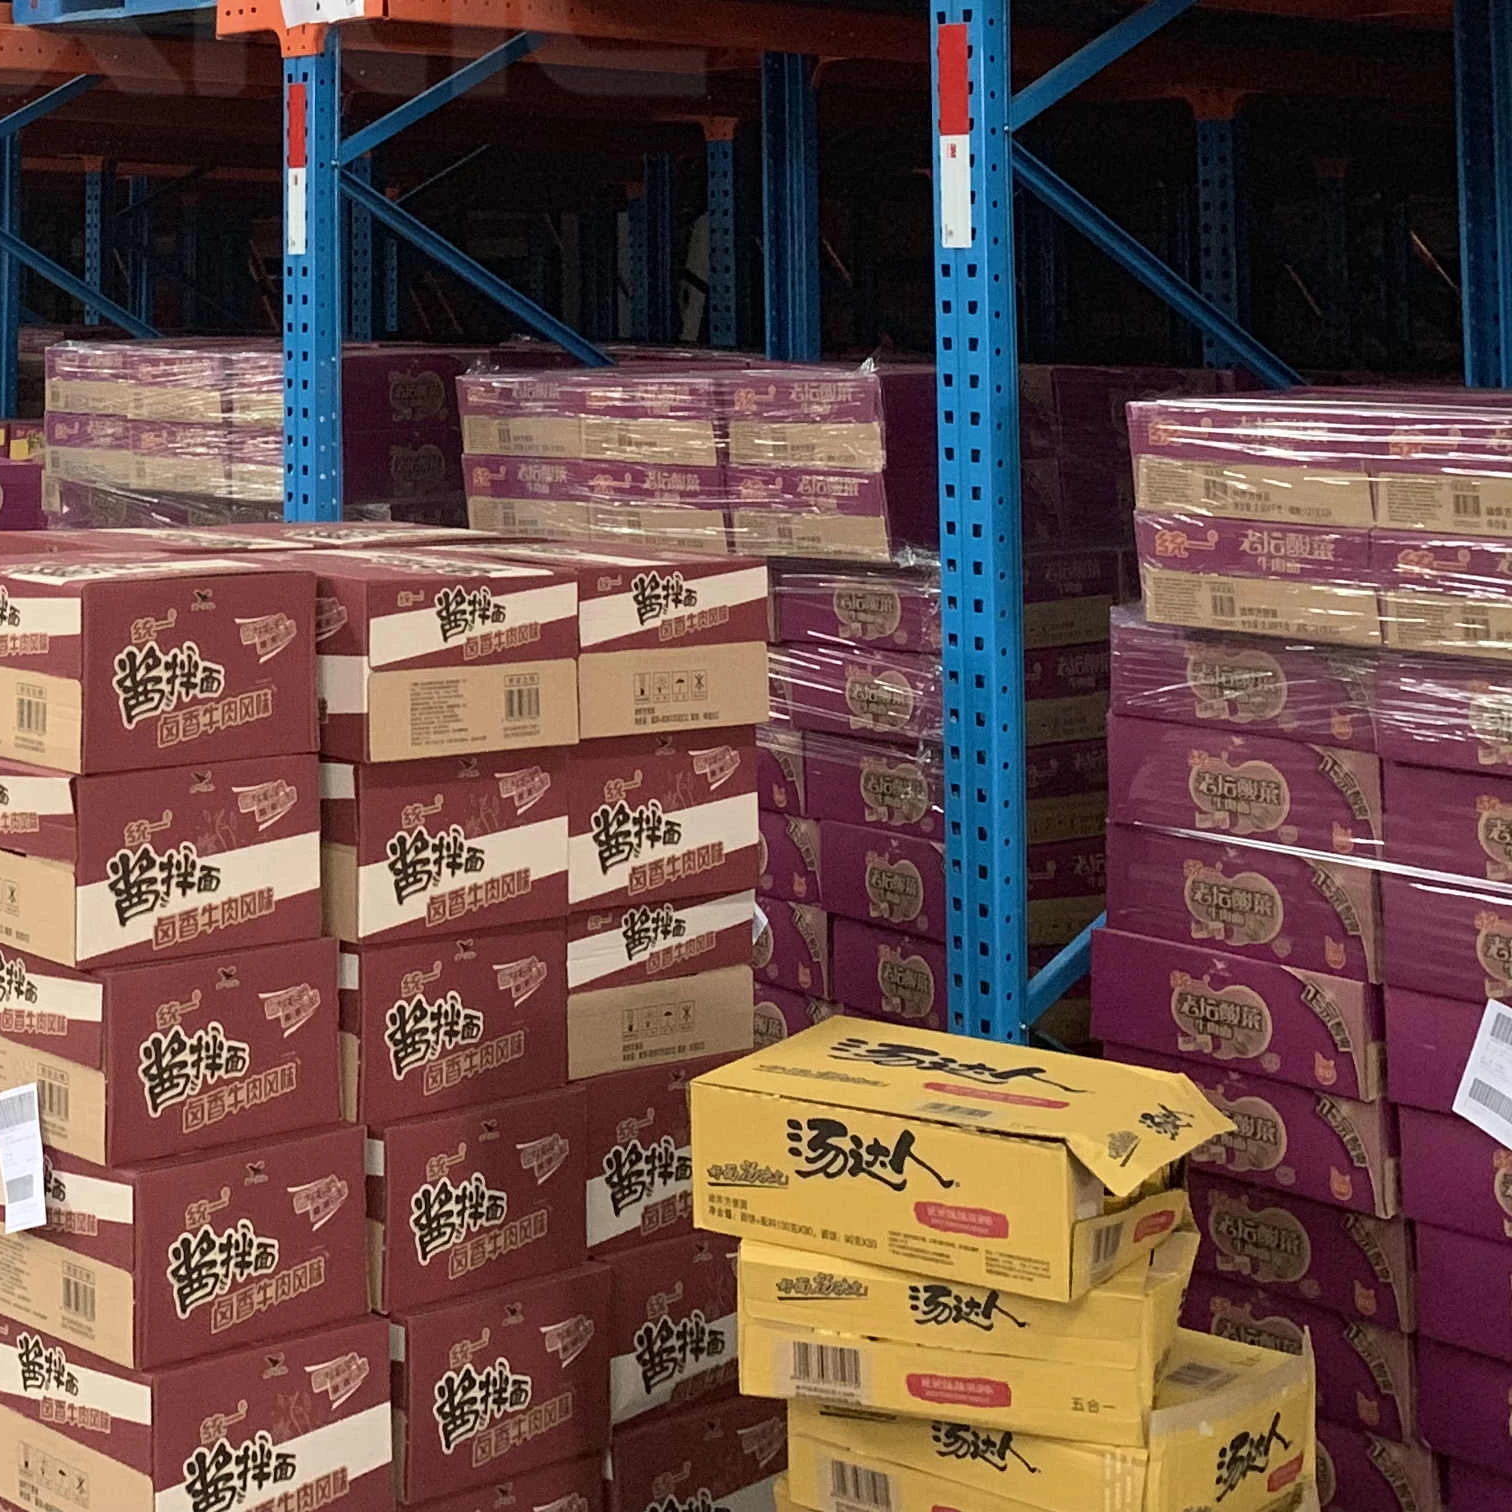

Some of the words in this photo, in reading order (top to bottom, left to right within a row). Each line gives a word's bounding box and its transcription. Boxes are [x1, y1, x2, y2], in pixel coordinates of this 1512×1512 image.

[1239, 528, 1336, 561] 老坛酸菜
[130, 609, 177, 642] 统一
[435, 586, 506, 643] 酱拌面
[632, 571, 697, 626] 酱拌面
[658, 605, 729, 641] 卤香牛肉风味
[464, 622, 541, 660] 卤香牛肉风味
[113, 641, 224, 729] 酱拌面
[158, 693, 273, 748] 卤香牛肉风味
[1198, 770, 1283, 806] 老坛酸菜
[124, 810, 172, 845] 统一
[592, 800, 681, 875] 酱拌面
[108, 843, 221, 926] 酱拌面
[386, 825, 484, 904] 酱拌面
[629, 842, 724, 895] 卤香牛肉风味
[153, 887, 275, 949] 卤香牛肉风味
[426, 868, 531, 926] 卤香牛肉风味
[622, 904, 686, 960] 酱拌面
[1, 1007, 67, 1034] 卤香牛肉风味
[156, 990, 201, 1027] 统一
[386, 991, 483, 1079] 酱拌面
[1179, 995, 1264, 1032] 老坛酸菜
[138, 1022, 248, 1115] 酱拌面
[423, 1029, 525, 1096] 卤香牛肉风味
[827, 1037, 1093, 1094] 汤达人
[183, 1064, 296, 1134] 卤香牛肉风味
[786, 1117, 955, 1191] 汤达人
[185, 1188, 230, 1228] 统一
[410, 1171, 506, 1265] 酱拌面
[167, 1219, 278, 1318] 酱拌面
[448, 1209, 548, 1279] 卤香牛肉风味
[211, 1257, 326, 1333] 卤香牛肉风味
[908, 1285, 1027, 1330] 汤达人
[17, 1332, 79, 1395] 酱拌面
[634, 1309, 725, 1395] 酱拌面
[40, 1396, 112, 1433] 卤香牛肉风味
[200, 1399, 248, 1441] 统一
[434, 1357, 531, 1454] 酱拌面
[472, 1398, 572, 1467] 卤香牛肉风味
[1071, 1397, 1116, 1414] 五合一
[185, 1430, 295, 1512] 酱拌面
[932, 1420, 1039, 1474] 汤达人
[1216, 1412, 1289, 1502] 汤达人
